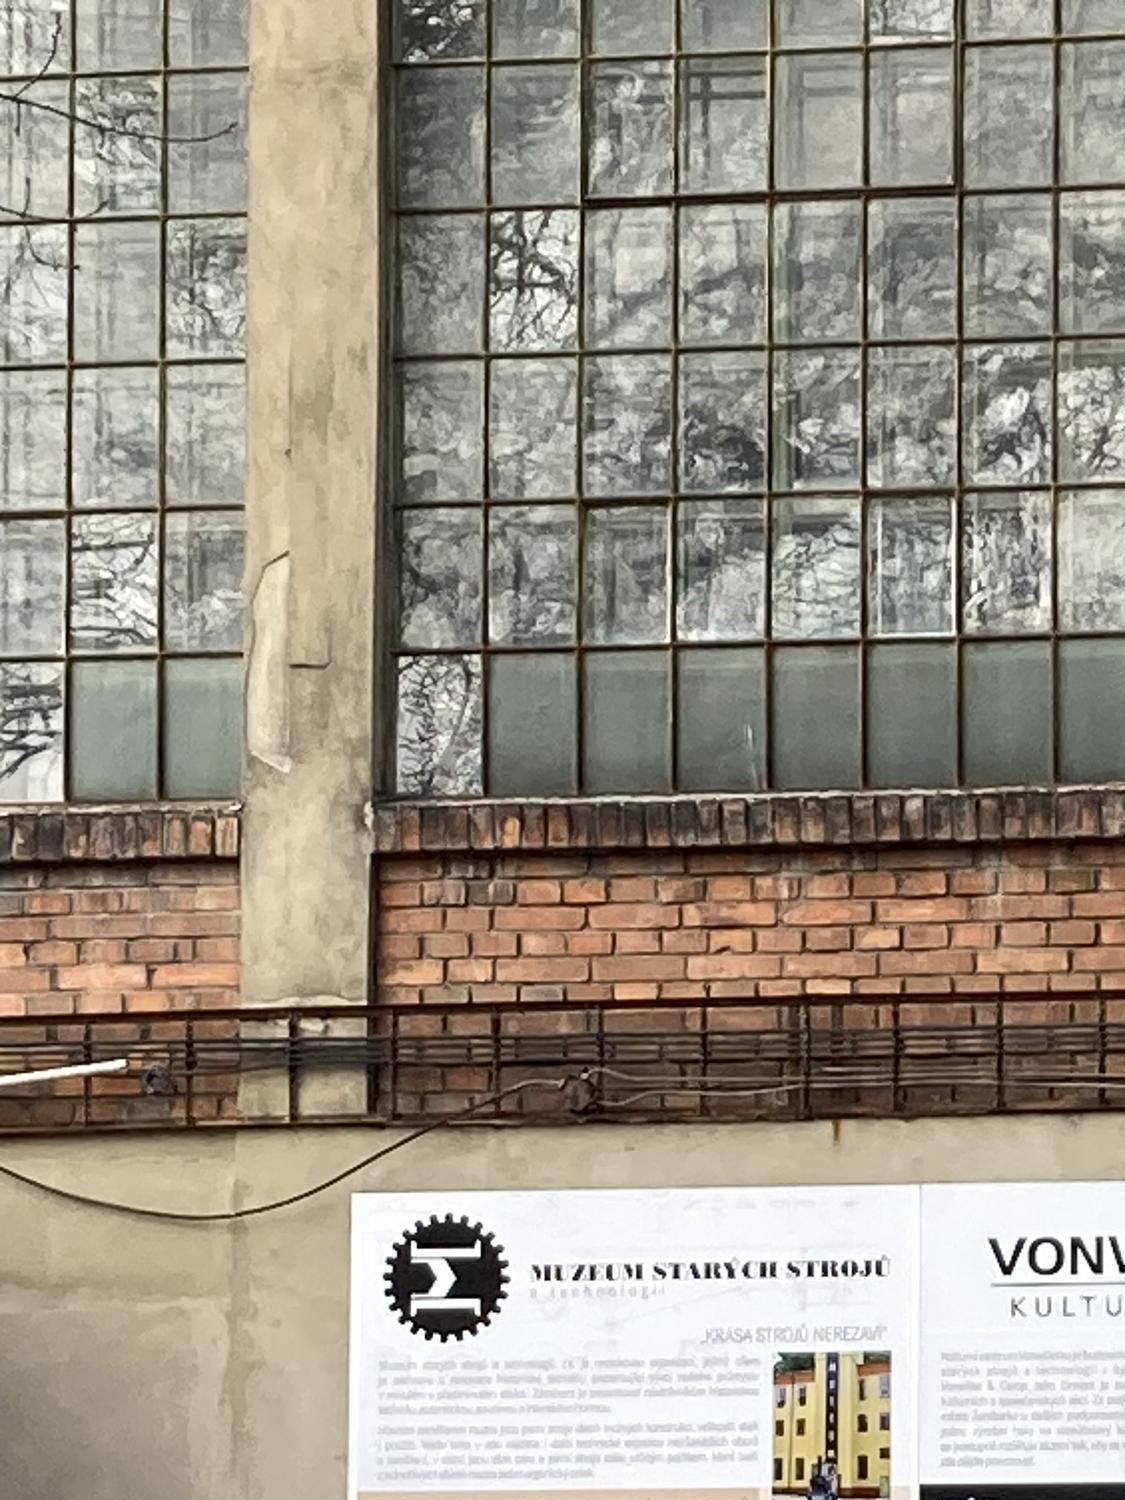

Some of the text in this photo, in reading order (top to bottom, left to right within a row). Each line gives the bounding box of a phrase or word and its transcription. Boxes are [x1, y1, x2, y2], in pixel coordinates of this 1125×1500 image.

[531, 1254, 891, 1282] MUZEUM STARÝCH STROJŮ
